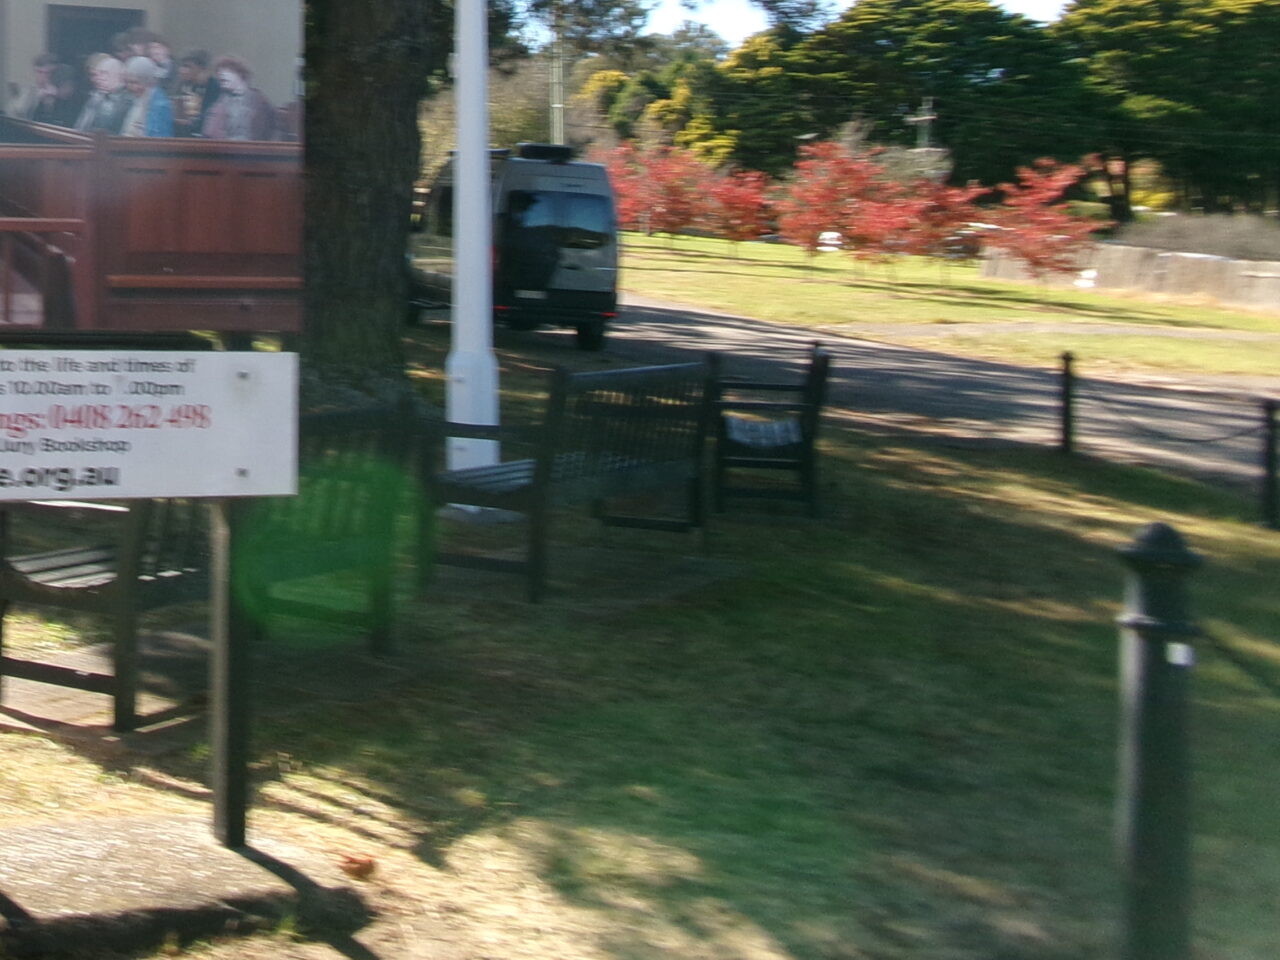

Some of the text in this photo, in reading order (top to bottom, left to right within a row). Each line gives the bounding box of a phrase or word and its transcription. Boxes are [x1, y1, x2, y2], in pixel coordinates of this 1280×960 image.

[20, 357, 49, 372] the
[54, 356, 83, 372] life
[86, 356, 120, 372] and
[122, 357, 172, 372] times
[174, 357, 196, 373] of
[89, 381, 111, 395] to
[47, 404, 111, 429] 0408
[112, 404, 162, 429] 262
[163, 404, 212, 429] 498
[39, 437, 131, 454] Bookshop
